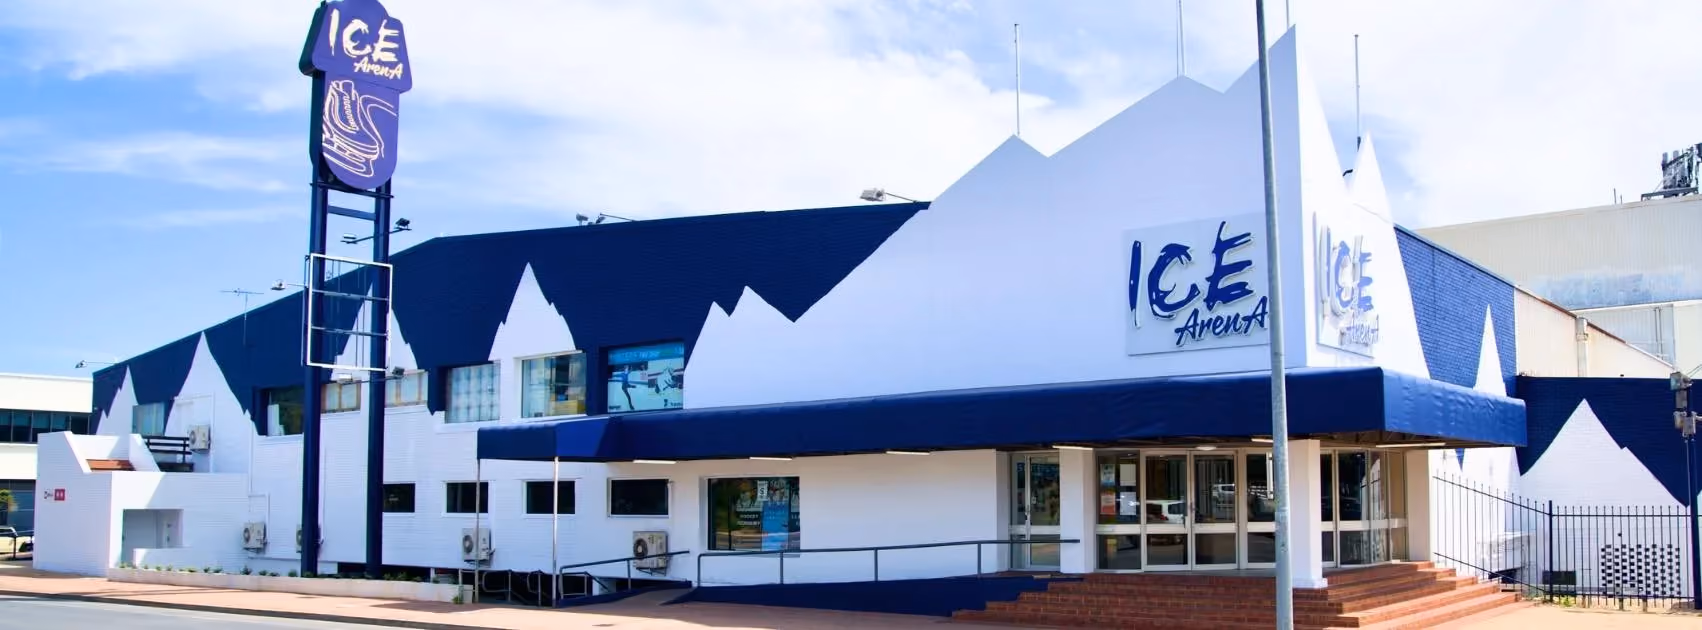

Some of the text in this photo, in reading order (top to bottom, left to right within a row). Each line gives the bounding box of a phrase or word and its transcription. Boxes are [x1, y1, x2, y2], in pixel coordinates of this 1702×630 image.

[328, 8, 400, 63] ICE
[353, 56, 404, 80] ArenA
[1128, 220, 1256, 329] ICE
[1319, 224, 1374, 317] ICE
[1174, 296, 1269, 347] ArenA
